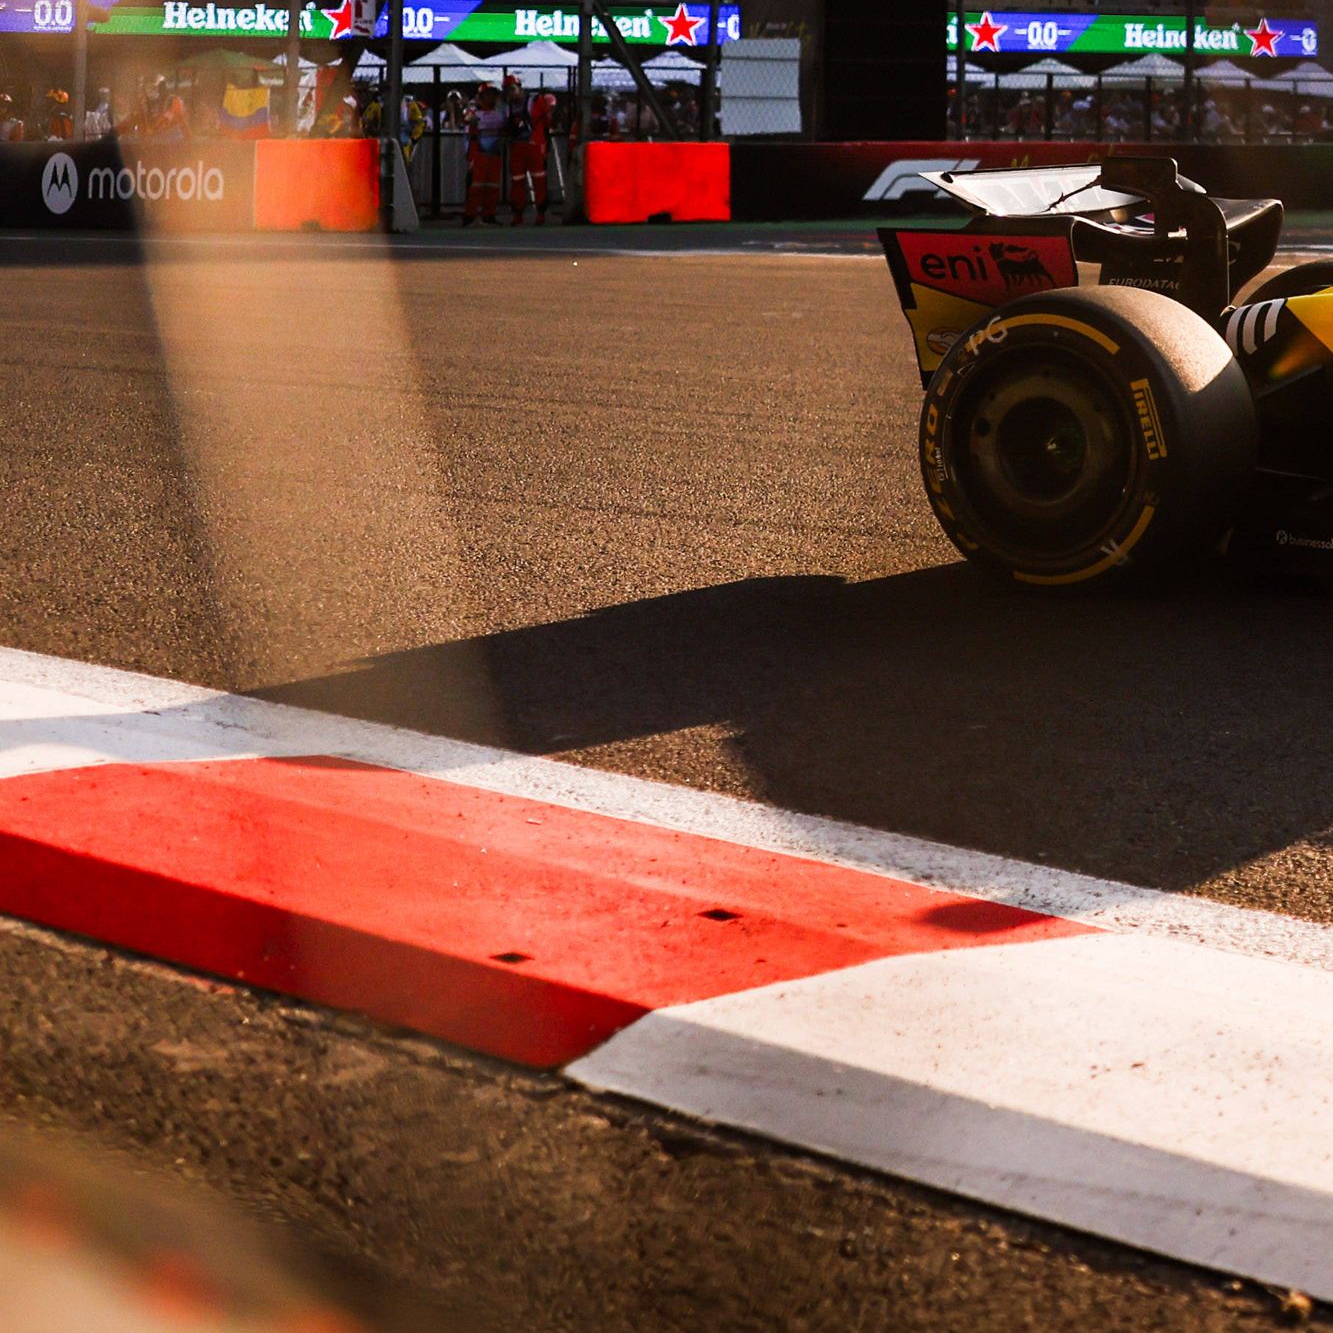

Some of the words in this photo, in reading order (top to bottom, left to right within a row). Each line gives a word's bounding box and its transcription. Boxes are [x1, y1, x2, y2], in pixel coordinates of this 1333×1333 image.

[87, 160, 224, 201] motorola
[919, 245, 987, 282] eni
[1130, 378, 1168, 460] PIRELLI
